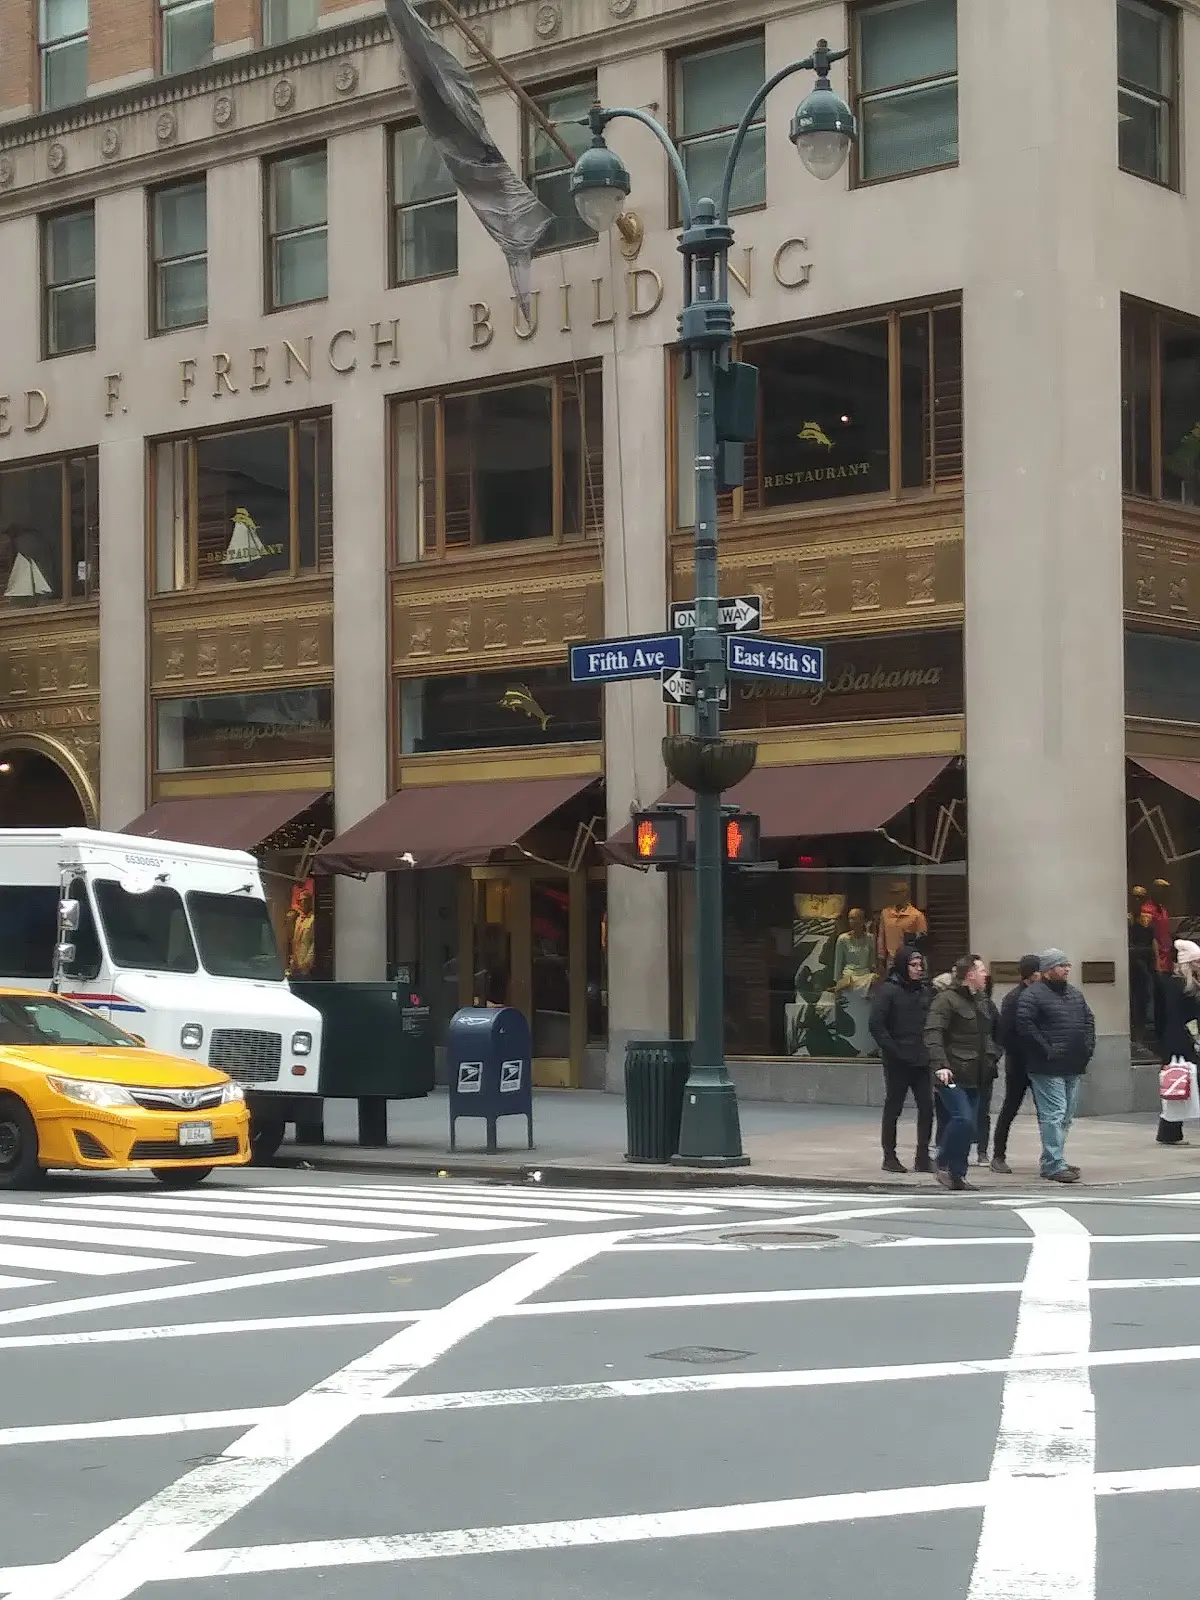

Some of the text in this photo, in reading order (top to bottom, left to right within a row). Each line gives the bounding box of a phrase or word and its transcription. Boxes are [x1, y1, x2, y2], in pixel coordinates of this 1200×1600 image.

[104, 371, 128, 418] F.
[177, 318, 401, 405] FRENCH
[469, 237, 814, 351] BUILDNG
[764, 462, 870, 488] RESTAURANT
[677, 607, 750, 627] ON WAY
[588, 649, 665, 673] Fifth Ave
[733, 645, 818, 675] East 45th St
[669, 680, 692, 694] ONE
[827, 664, 944, 692] Bahama
